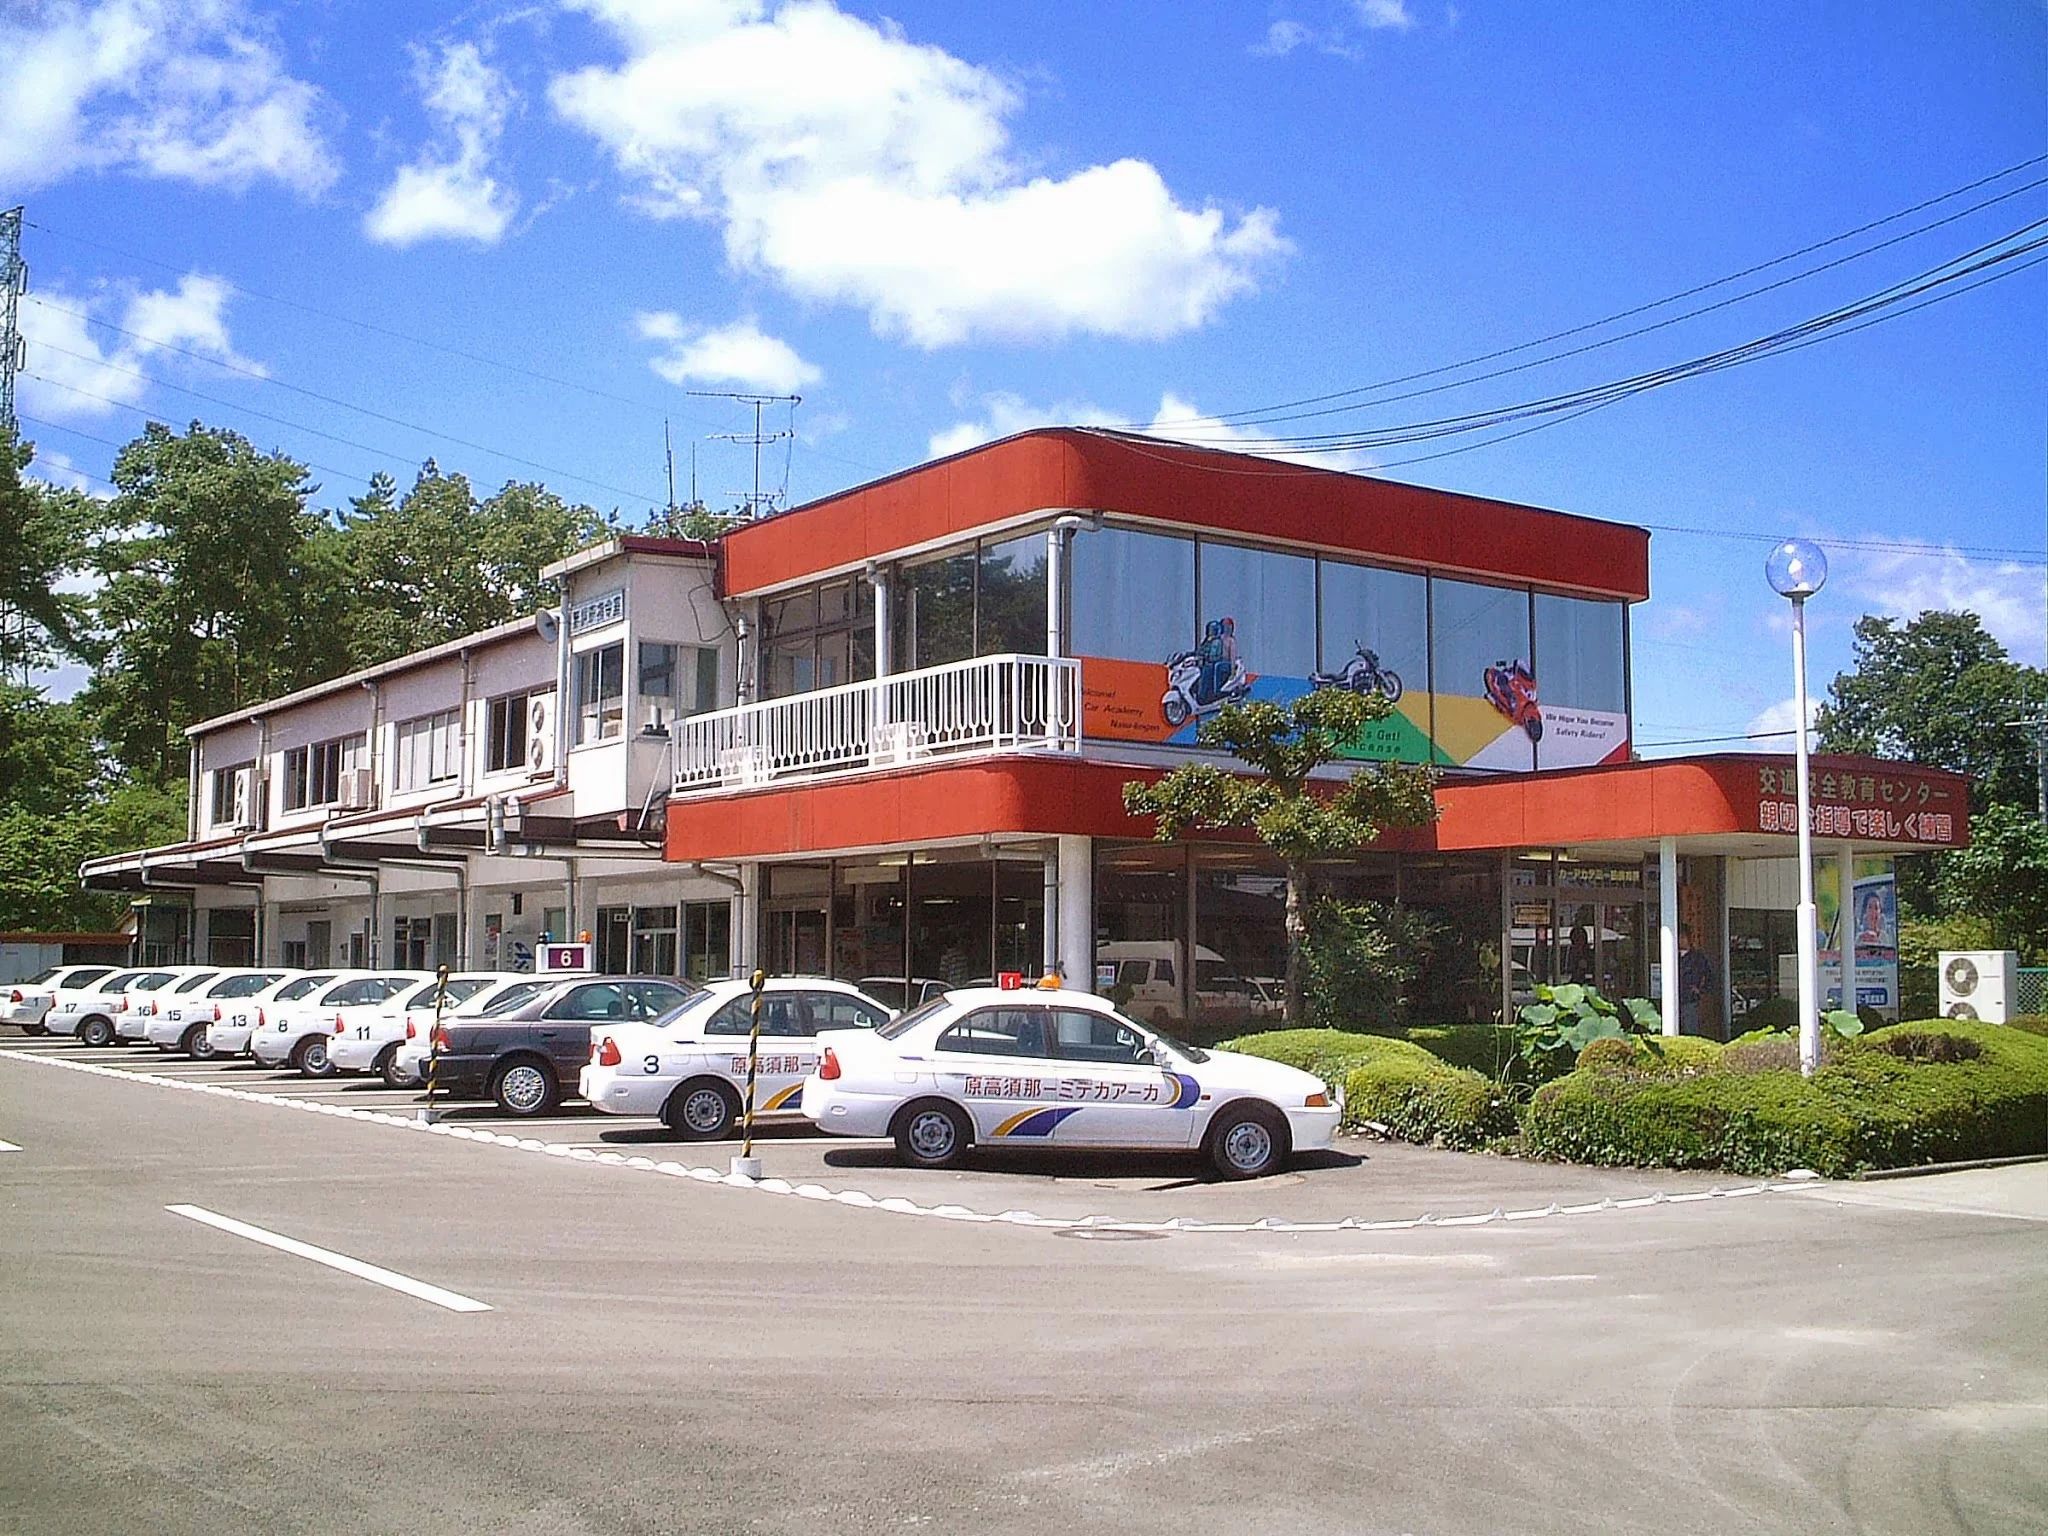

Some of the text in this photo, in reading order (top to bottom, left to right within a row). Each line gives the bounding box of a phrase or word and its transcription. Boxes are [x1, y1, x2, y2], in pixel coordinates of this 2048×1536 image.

[560, 950, 572, 967] 6
[65, 1003, 77, 1014] 17
[138, 1006, 151, 1017] 16
[167, 1009, 182, 1022] 15
[231, 1014, 247, 1028] 13
[278, 1019, 289, 1033] 8
[356, 1025, 371, 1041] 11
[643, 1054, 660, 1074] 3
